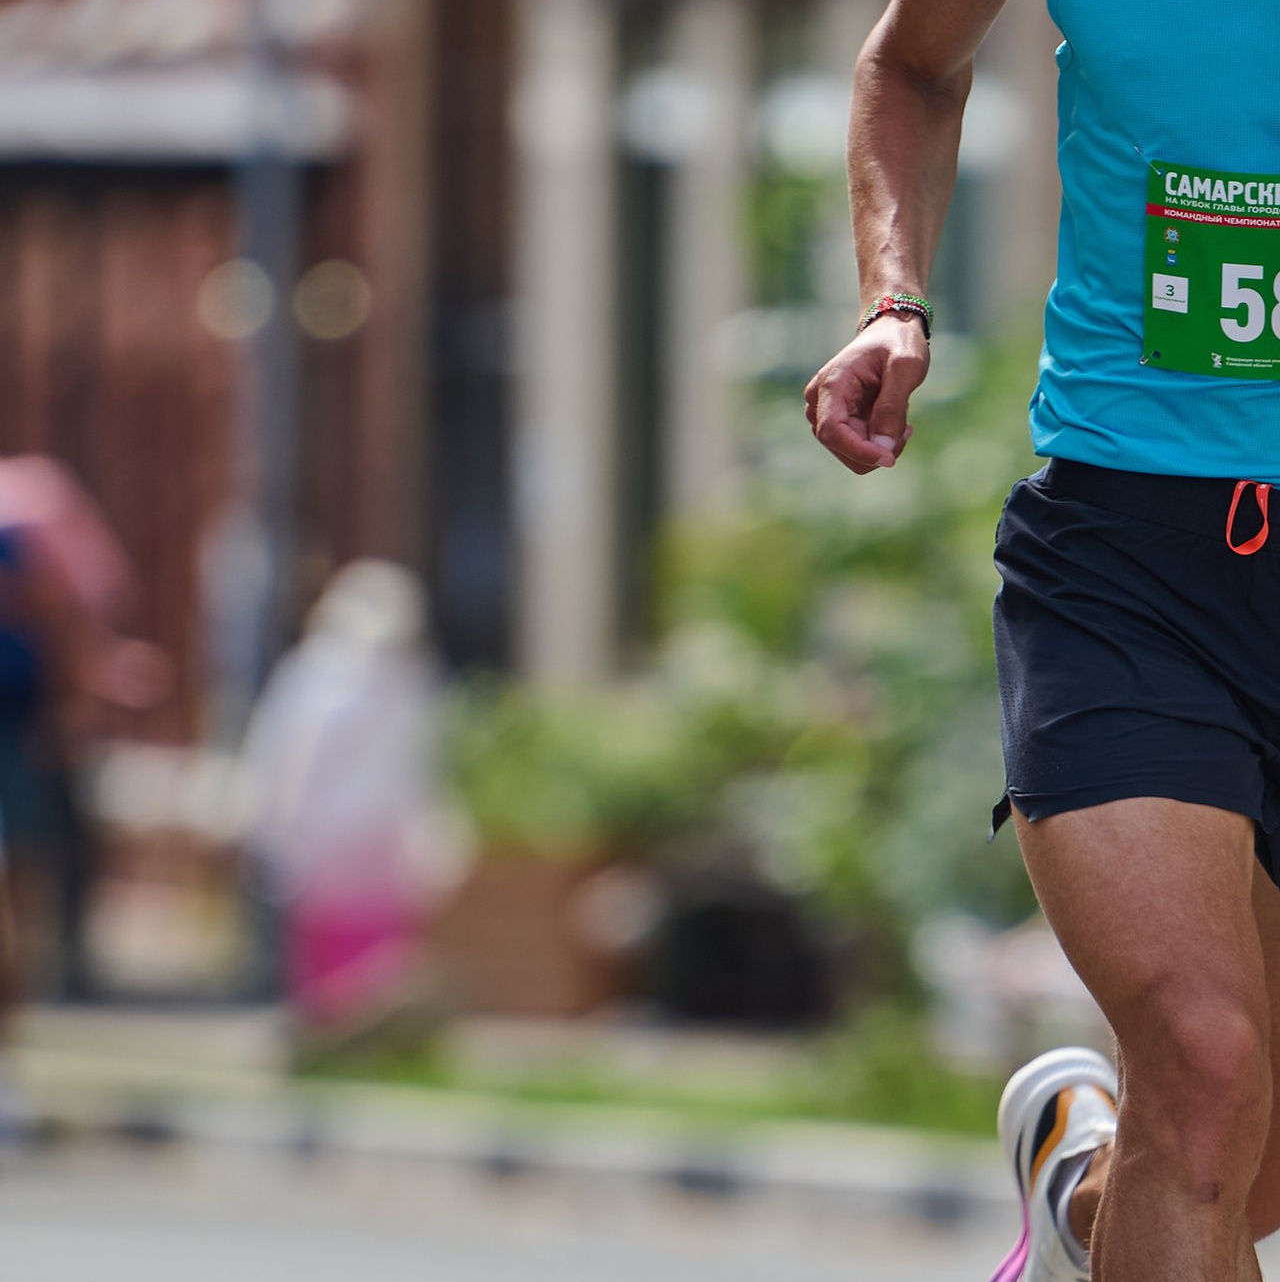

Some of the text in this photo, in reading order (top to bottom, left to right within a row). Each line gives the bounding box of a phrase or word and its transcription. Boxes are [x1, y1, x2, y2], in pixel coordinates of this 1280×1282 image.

[1165, 196, 1178, 205] НА
[1180, 198, 1211, 209] КУБОК
[1213, 203, 1245, 213] ГЛАВЫ
[1164, 208, 1223, 224] КОМАНДНЫЙ
[1224, 217, 1280, 227] ЧЕМПИОНАТ
